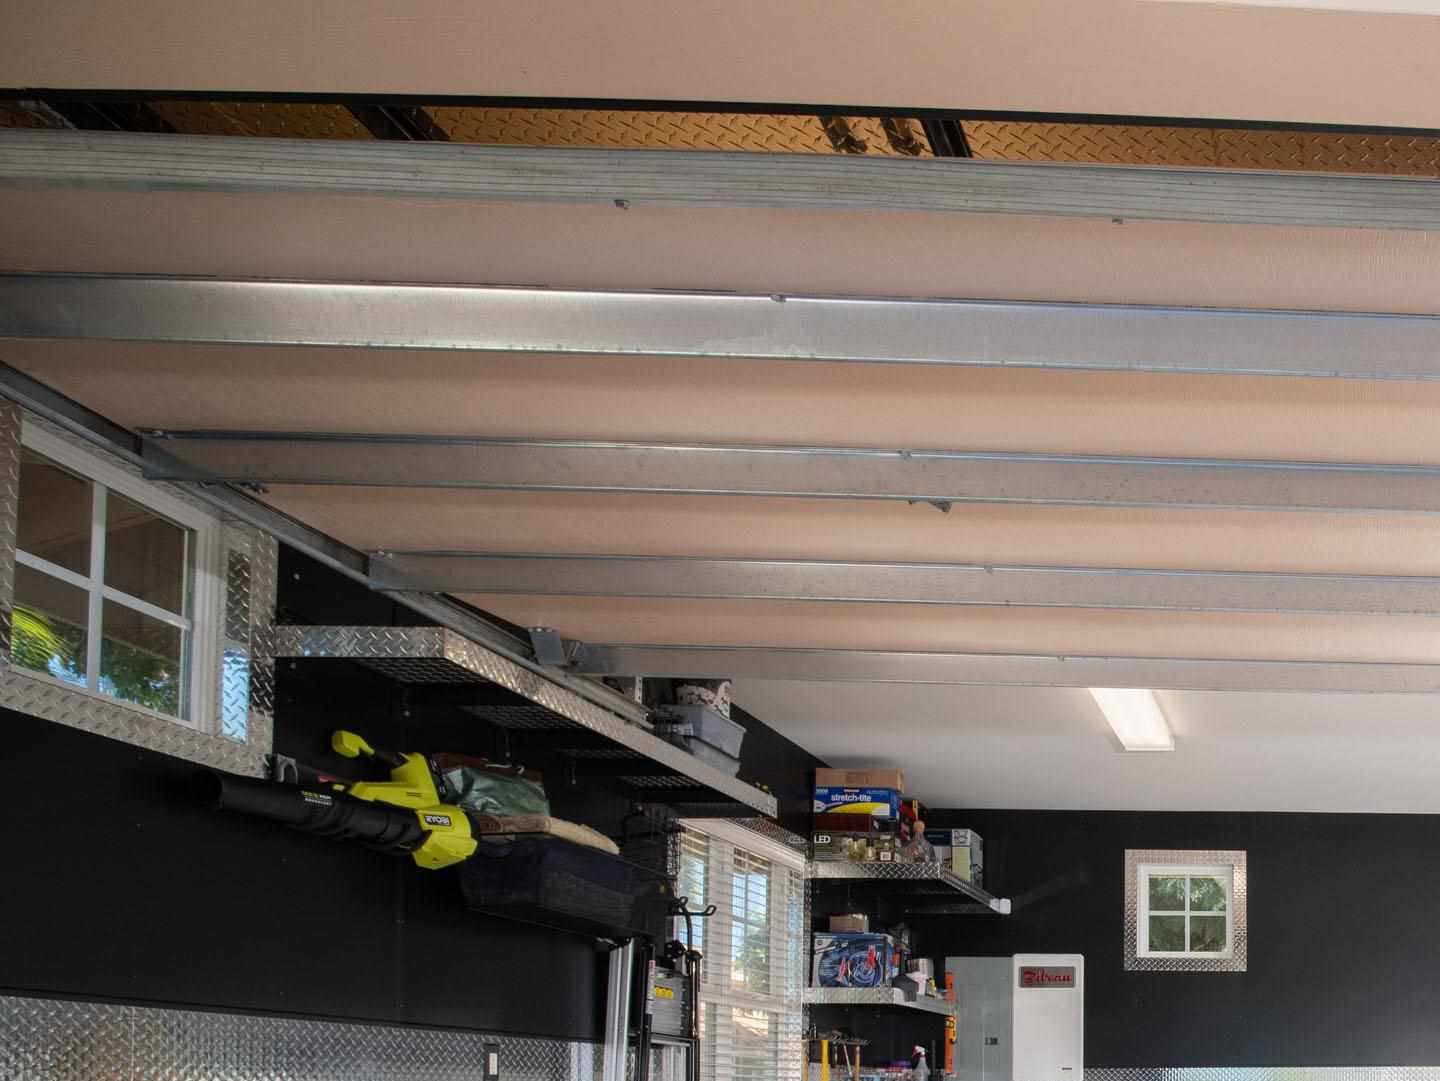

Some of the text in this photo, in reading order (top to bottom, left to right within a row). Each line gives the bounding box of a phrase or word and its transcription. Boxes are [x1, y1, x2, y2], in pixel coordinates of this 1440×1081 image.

[831, 793, 872, 802] stretch-tite
[425, 815, 450, 826] RYOBI
[814, 835, 831, 844] LED
